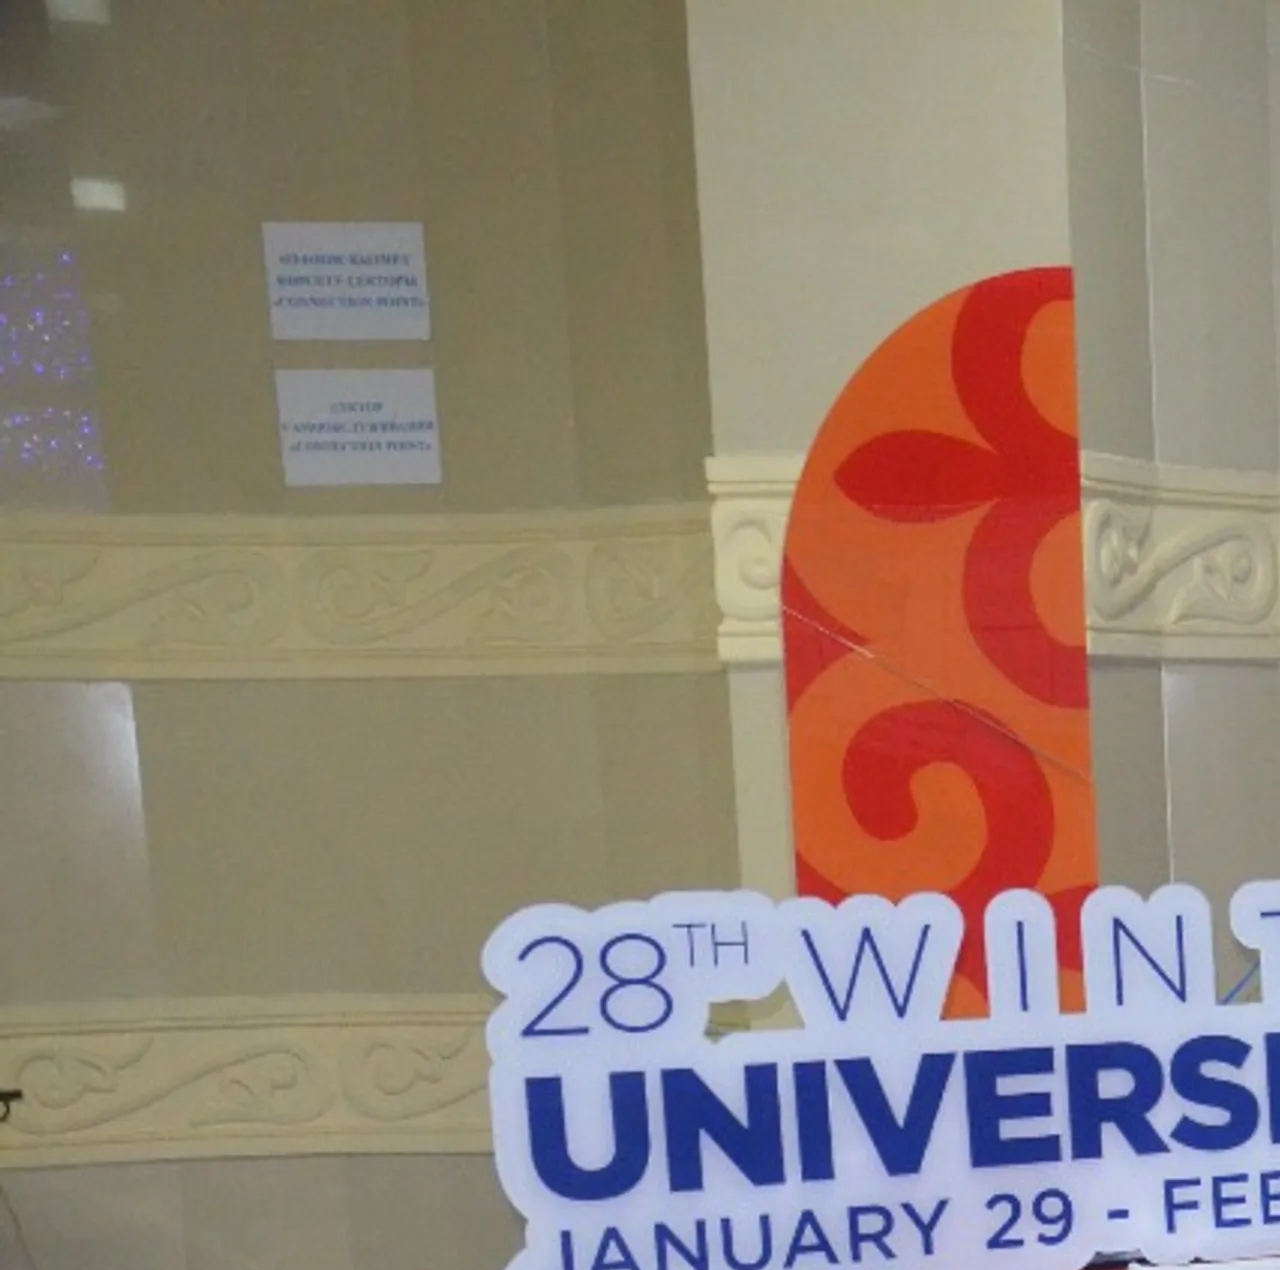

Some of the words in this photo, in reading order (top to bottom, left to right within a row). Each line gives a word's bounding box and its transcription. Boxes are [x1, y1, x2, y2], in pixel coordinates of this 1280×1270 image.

[518, 920, 750, 1038] 28TH
[984, 1187, 1074, 1250] 29
[1106, 1209, 1131, 1224] -
